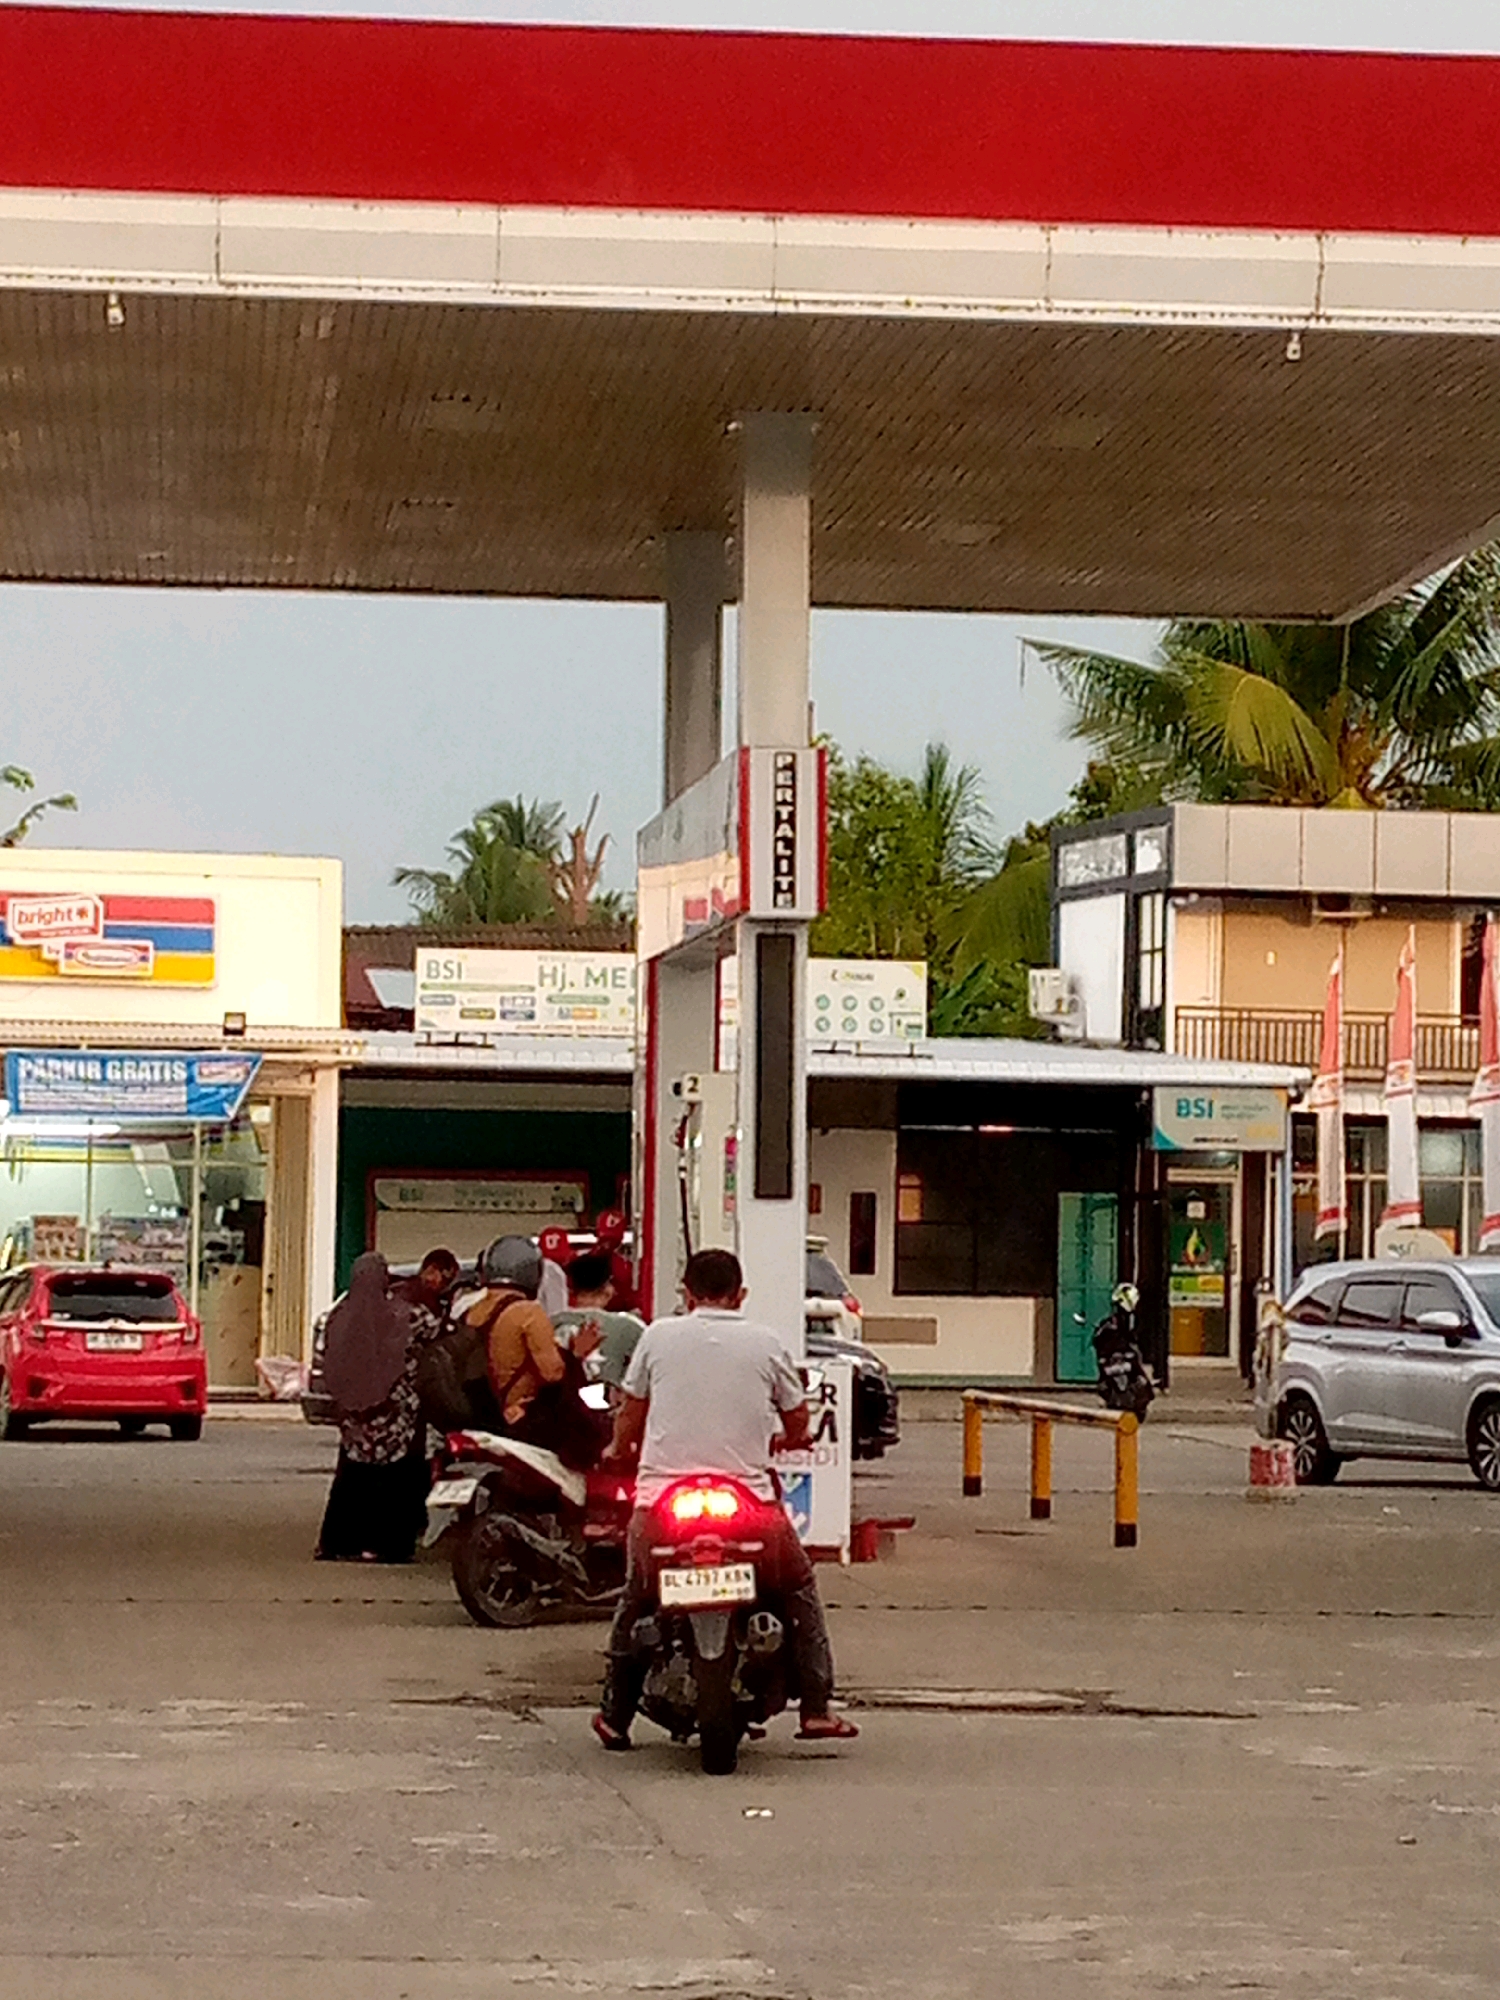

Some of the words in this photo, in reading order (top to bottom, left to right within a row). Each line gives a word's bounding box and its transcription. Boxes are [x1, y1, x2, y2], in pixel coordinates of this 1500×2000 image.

[775, 754, 795, 908] PERTALITE
[17, 906, 73, 926] bright
[426, 959, 463, 980] BSI
[538, 962, 575, 992] Hj.
[106, 1060, 187, 1082] GRATIS
[687, 1076, 699, 1093] 2
[1176, 1098, 1214, 1119] BSI
